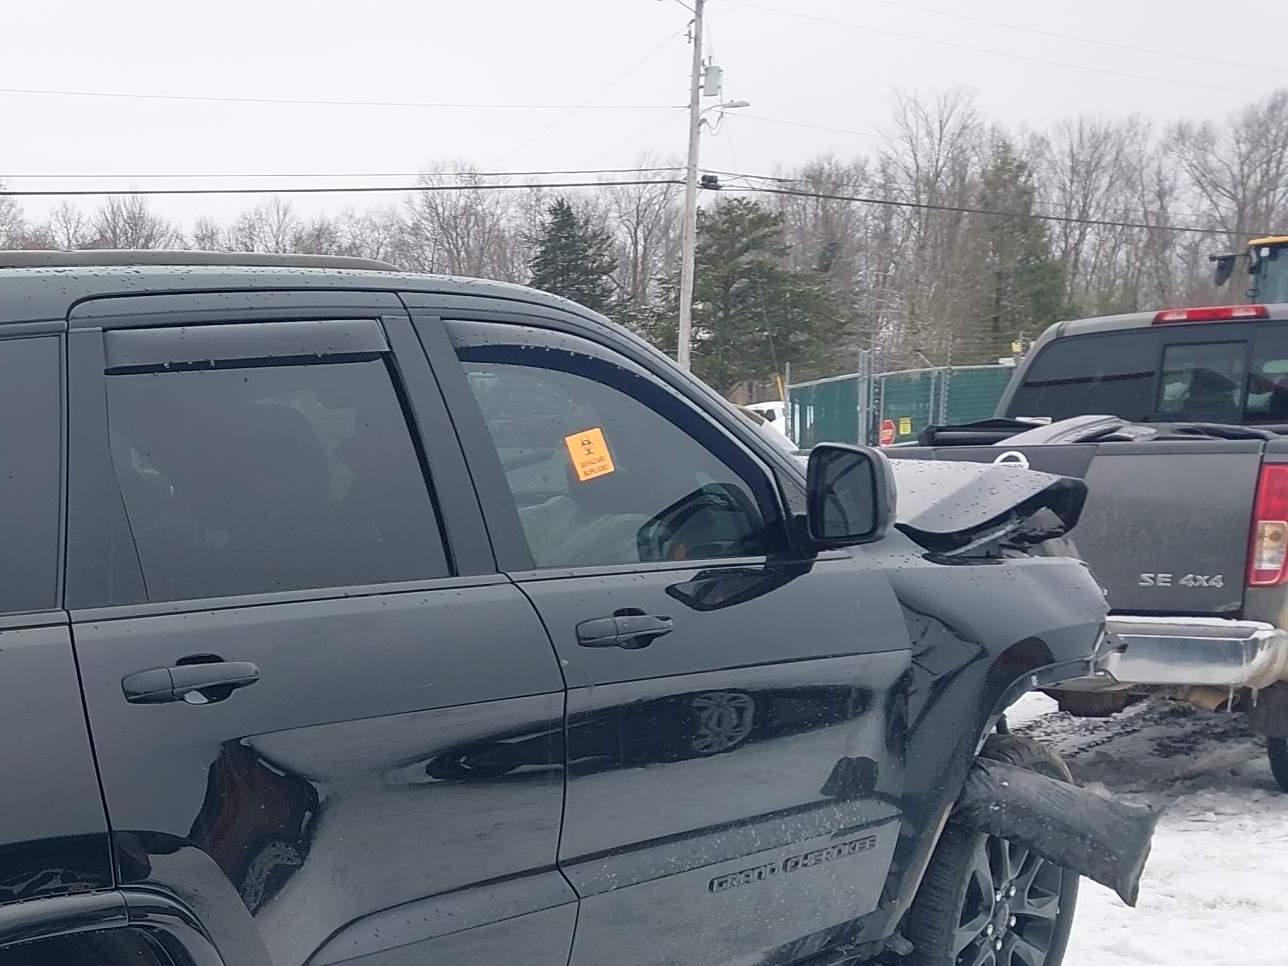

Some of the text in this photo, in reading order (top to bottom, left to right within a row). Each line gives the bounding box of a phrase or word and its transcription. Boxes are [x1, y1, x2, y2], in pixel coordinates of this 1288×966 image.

[1138, 573, 1173, 587] SE
[708, 834, 877, 893] GRAND CHEROKEE
